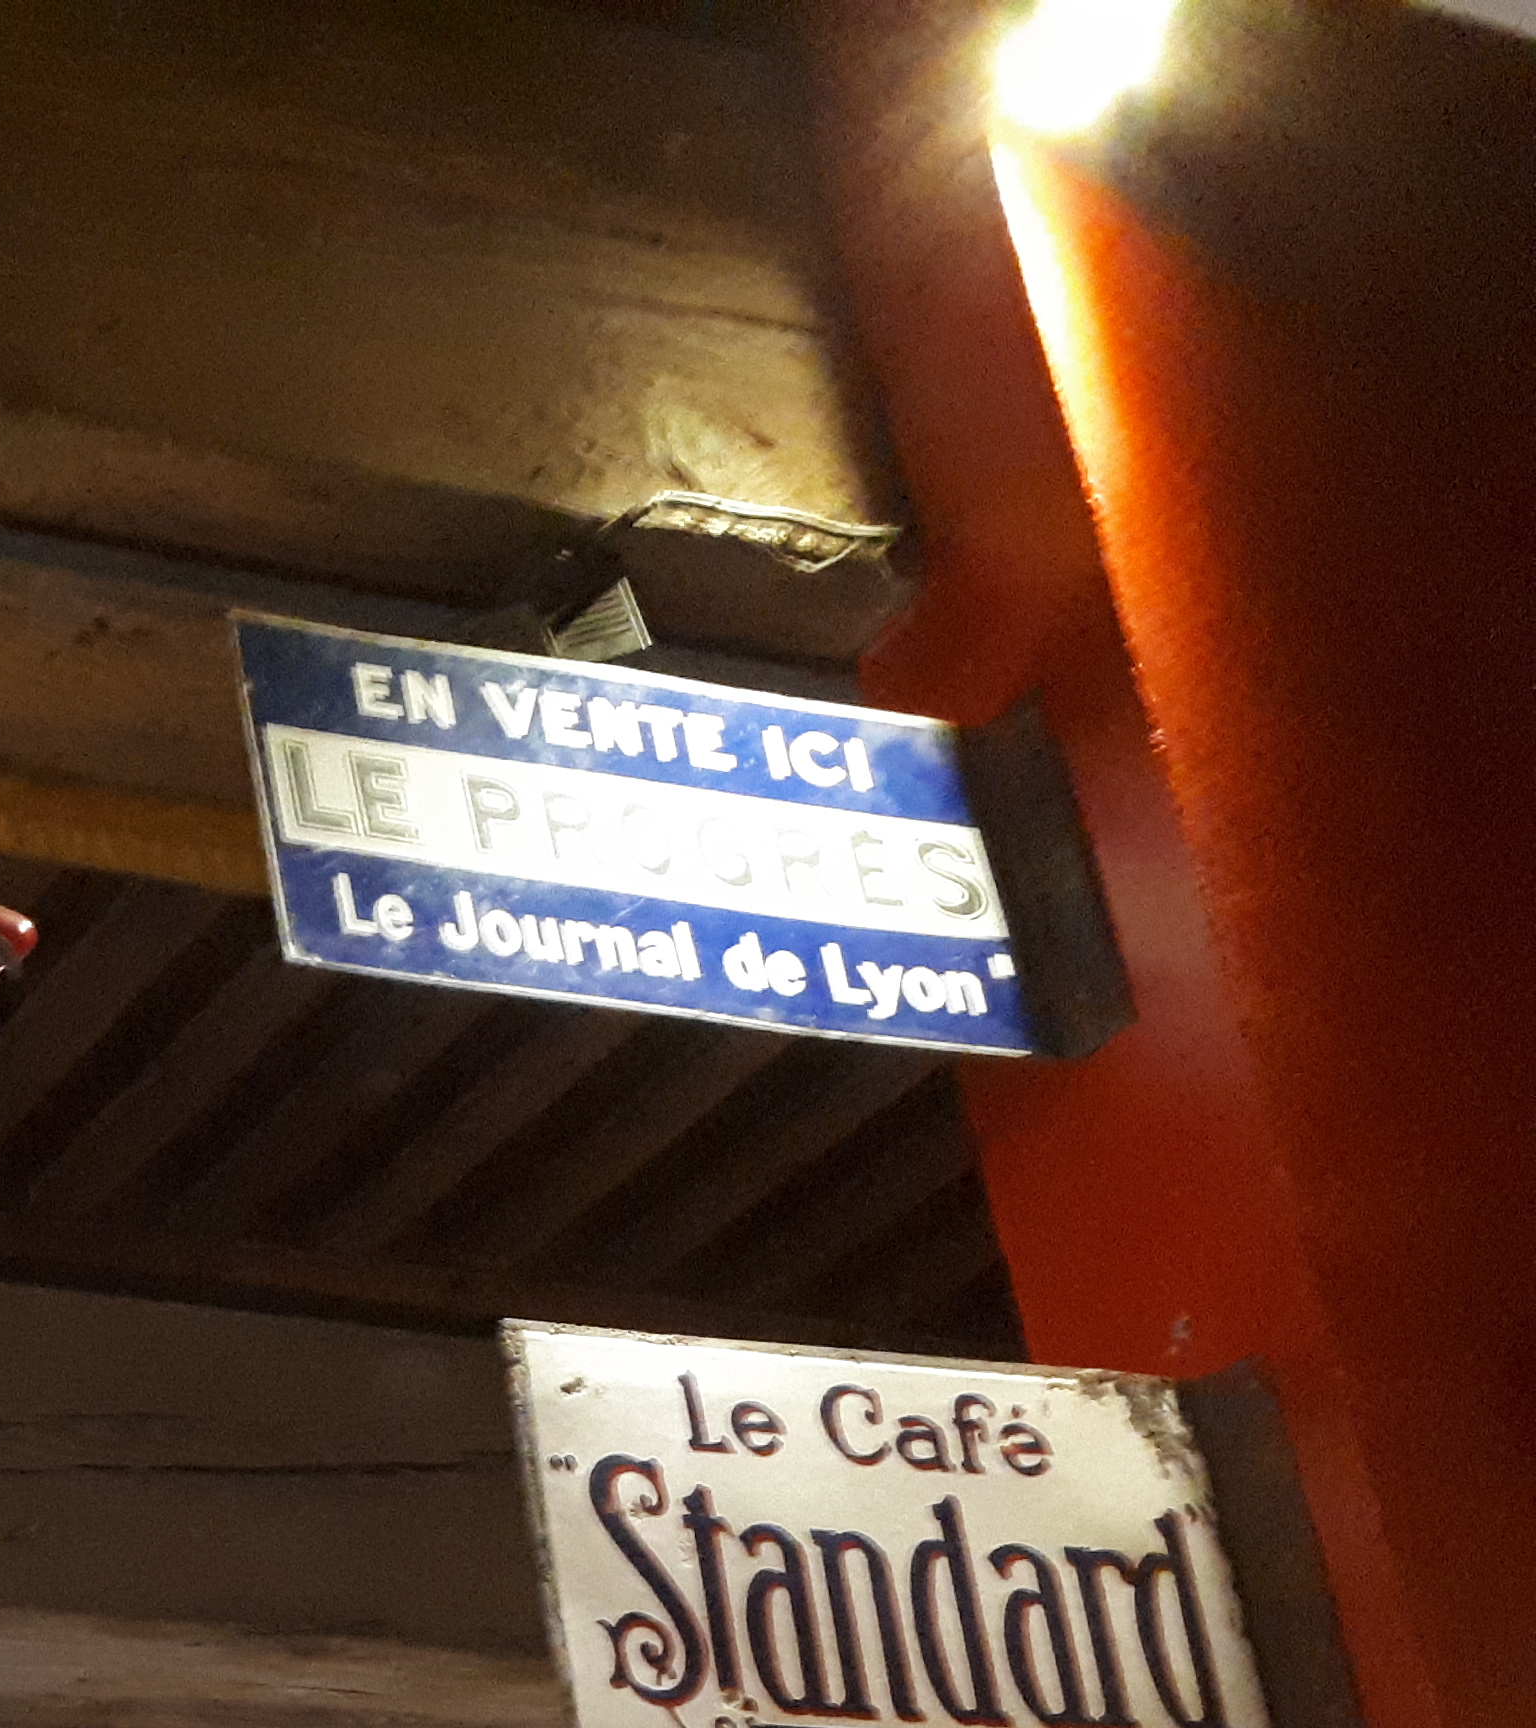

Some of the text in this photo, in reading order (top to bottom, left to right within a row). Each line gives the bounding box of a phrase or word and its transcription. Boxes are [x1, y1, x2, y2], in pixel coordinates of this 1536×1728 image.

[351, 664, 876, 792] EN VENTE ICI
[276, 738, 423, 844] LE
[334, 873, 414, 943] Le
[439, 892, 701, 982] Journal
[724, 931, 808, 997] de
[678, 1372, 1055, 1475] Le Café
